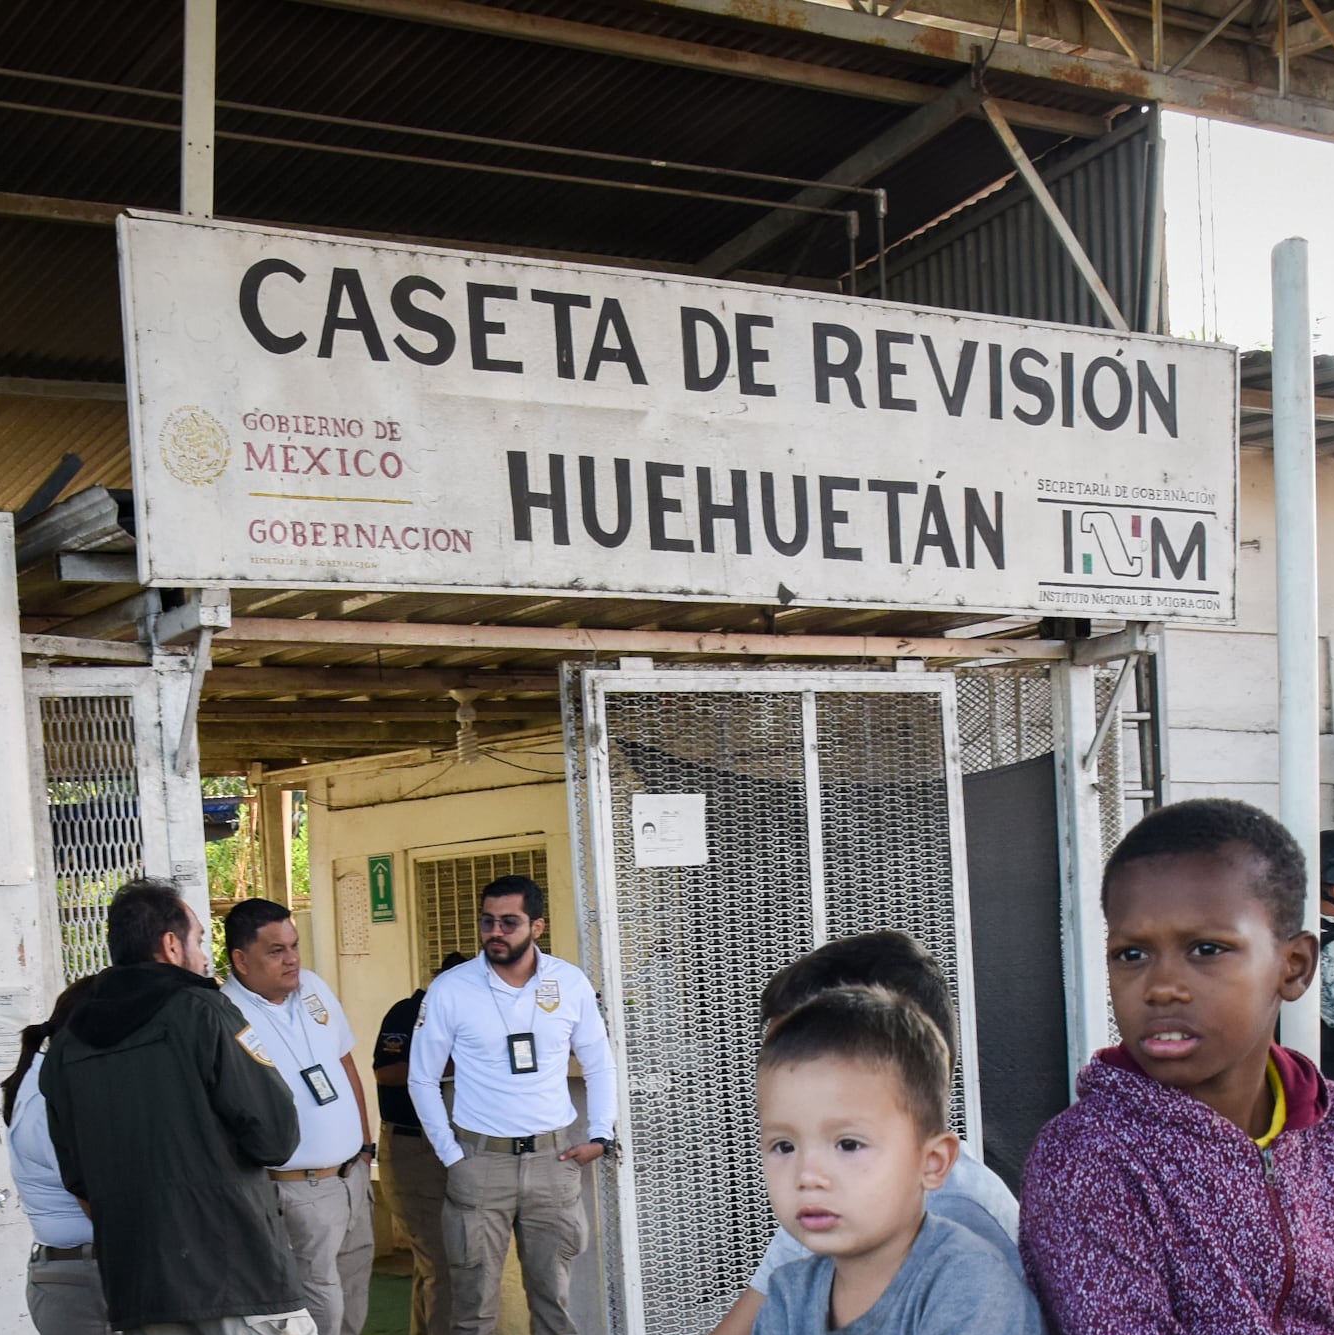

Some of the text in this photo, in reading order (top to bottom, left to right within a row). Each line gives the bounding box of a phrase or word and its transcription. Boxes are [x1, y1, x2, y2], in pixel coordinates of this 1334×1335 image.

[239, 258, 1178, 439] CASETA DE REVISIÓN
[242, 412, 402, 442] GOBIERNO DE
[242, 436, 403, 479] MÉXICO
[1114, 485, 1128, 498] DE
[506, 451, 1005, 570] HUEHUETÁN
[248, 519, 474, 554] GOBERNACION
[1039, 590, 1090, 604] INSTITUTO
[1091, 592, 1139, 606] NACIONAL
[1141, 597, 1153, 608] DE
